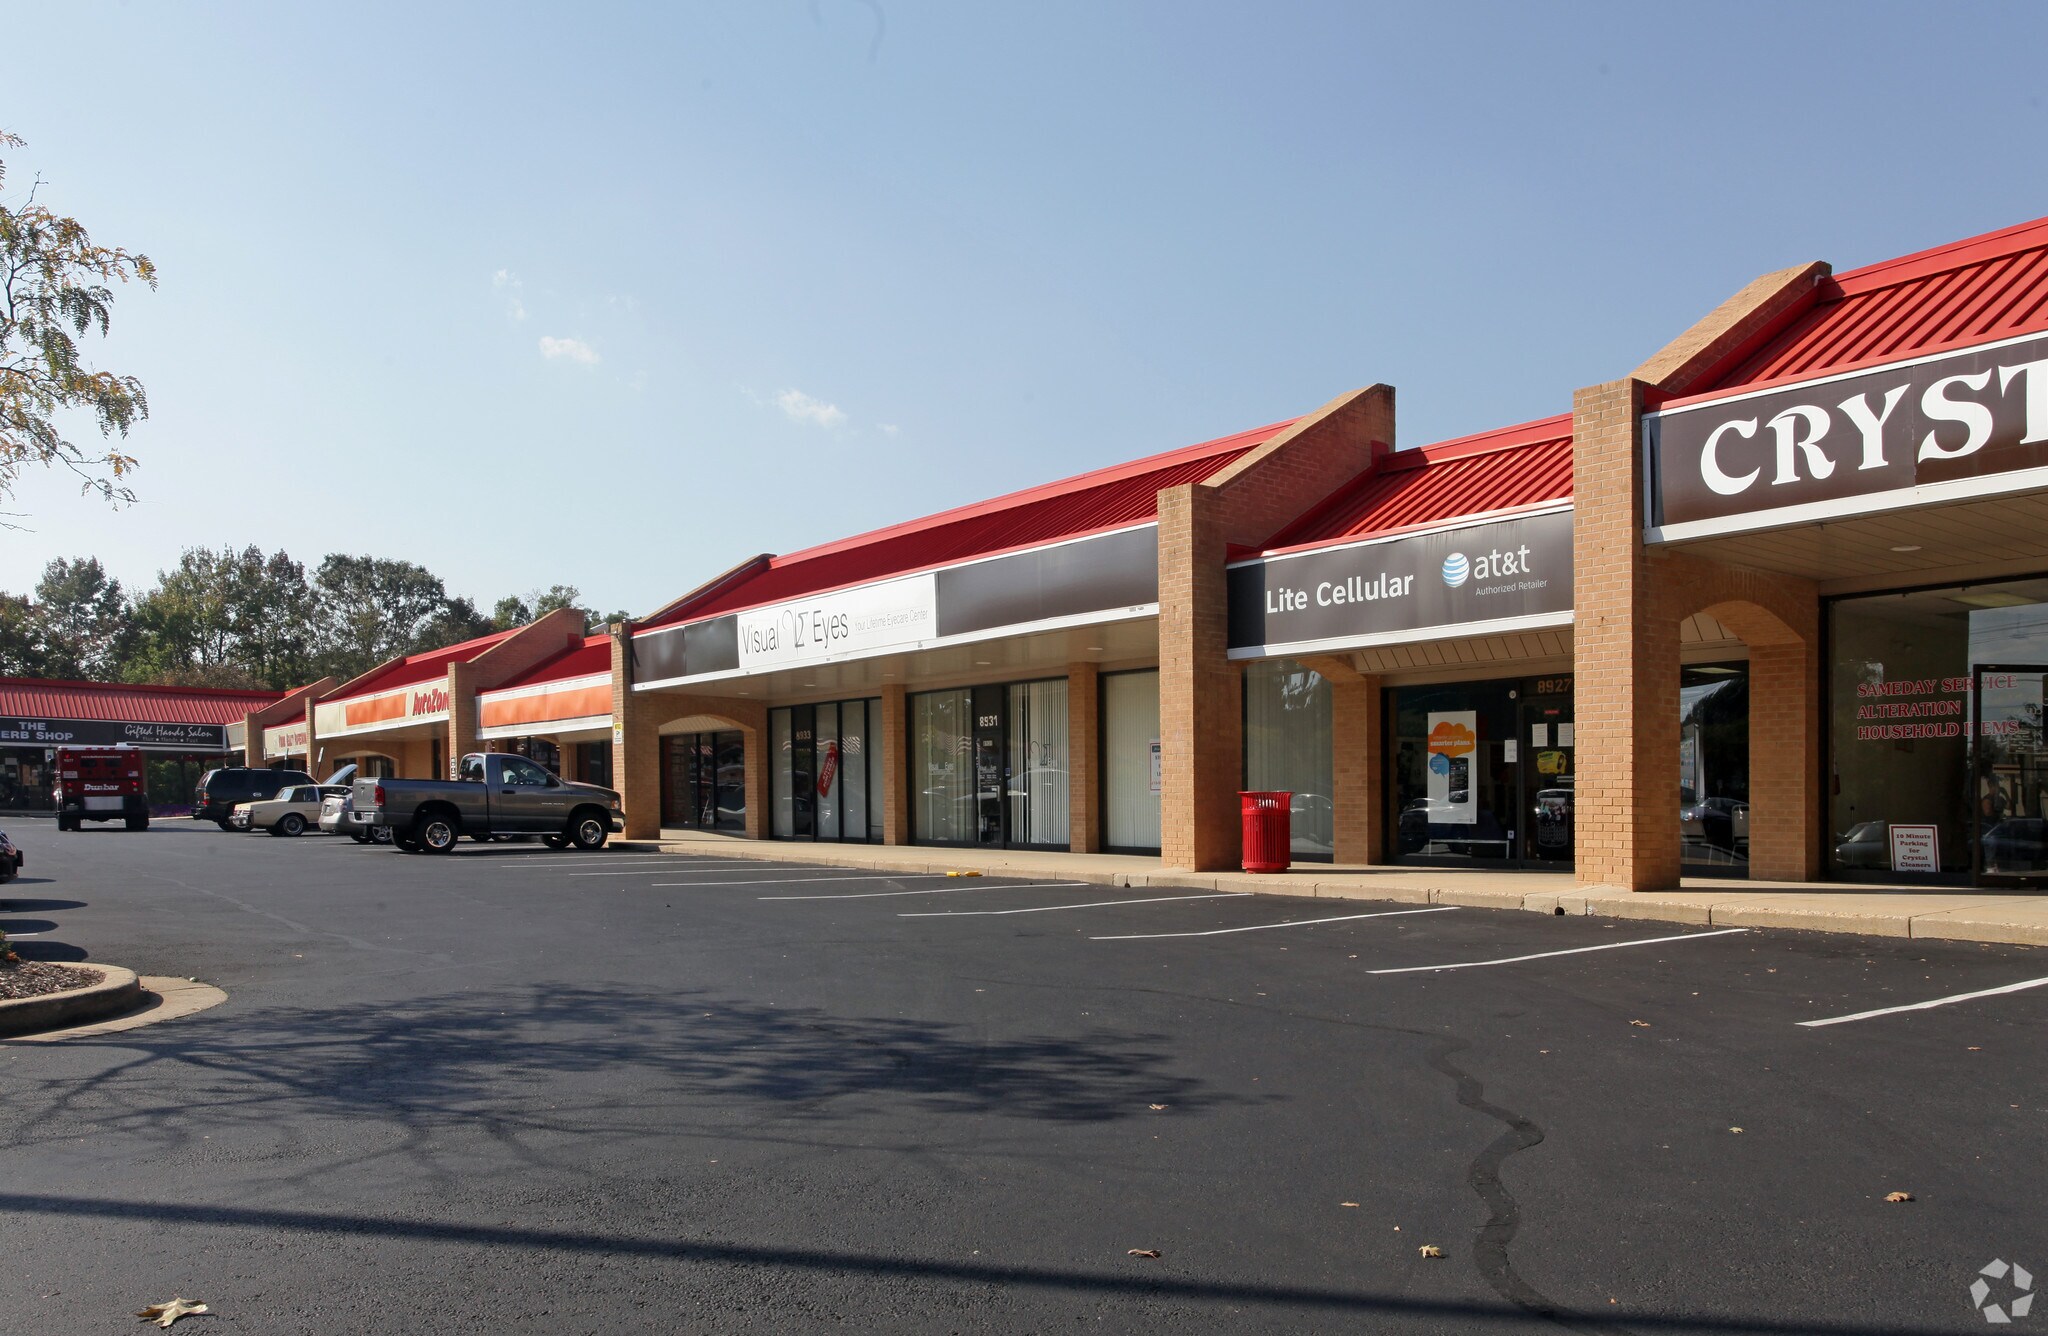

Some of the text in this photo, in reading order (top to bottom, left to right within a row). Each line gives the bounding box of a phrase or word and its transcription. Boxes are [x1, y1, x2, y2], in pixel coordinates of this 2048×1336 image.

[1700, 359, 2048, 496] CRYST
[1474, 544, 1531, 580] at&t
[1266, 572, 1415, 614] Lite Cellular
[1476, 579, 1548, 596] Authorized Retailer
[909, 609, 928, 622] Center
[741, 619, 780, 655] Visual
[813, 609, 849, 649] Eyes
[1537, 678, 1572, 694] 8927
[1857, 679, 1937, 698] SAMEDAY
[412, 688, 449, 716] AutoZon
[1856, 700, 1962, 720] ALTERATION
[18, 721, 47, 731] THE
[125, 719, 213, 739] Gifted Hands Salon
[979, 715, 998, 727] 8931
[1, 730, 74, 741] ERB SHOP
[1857, 722, 1960, 741] HOUSEHOLD
[83, 783, 120, 791] Dunbar
